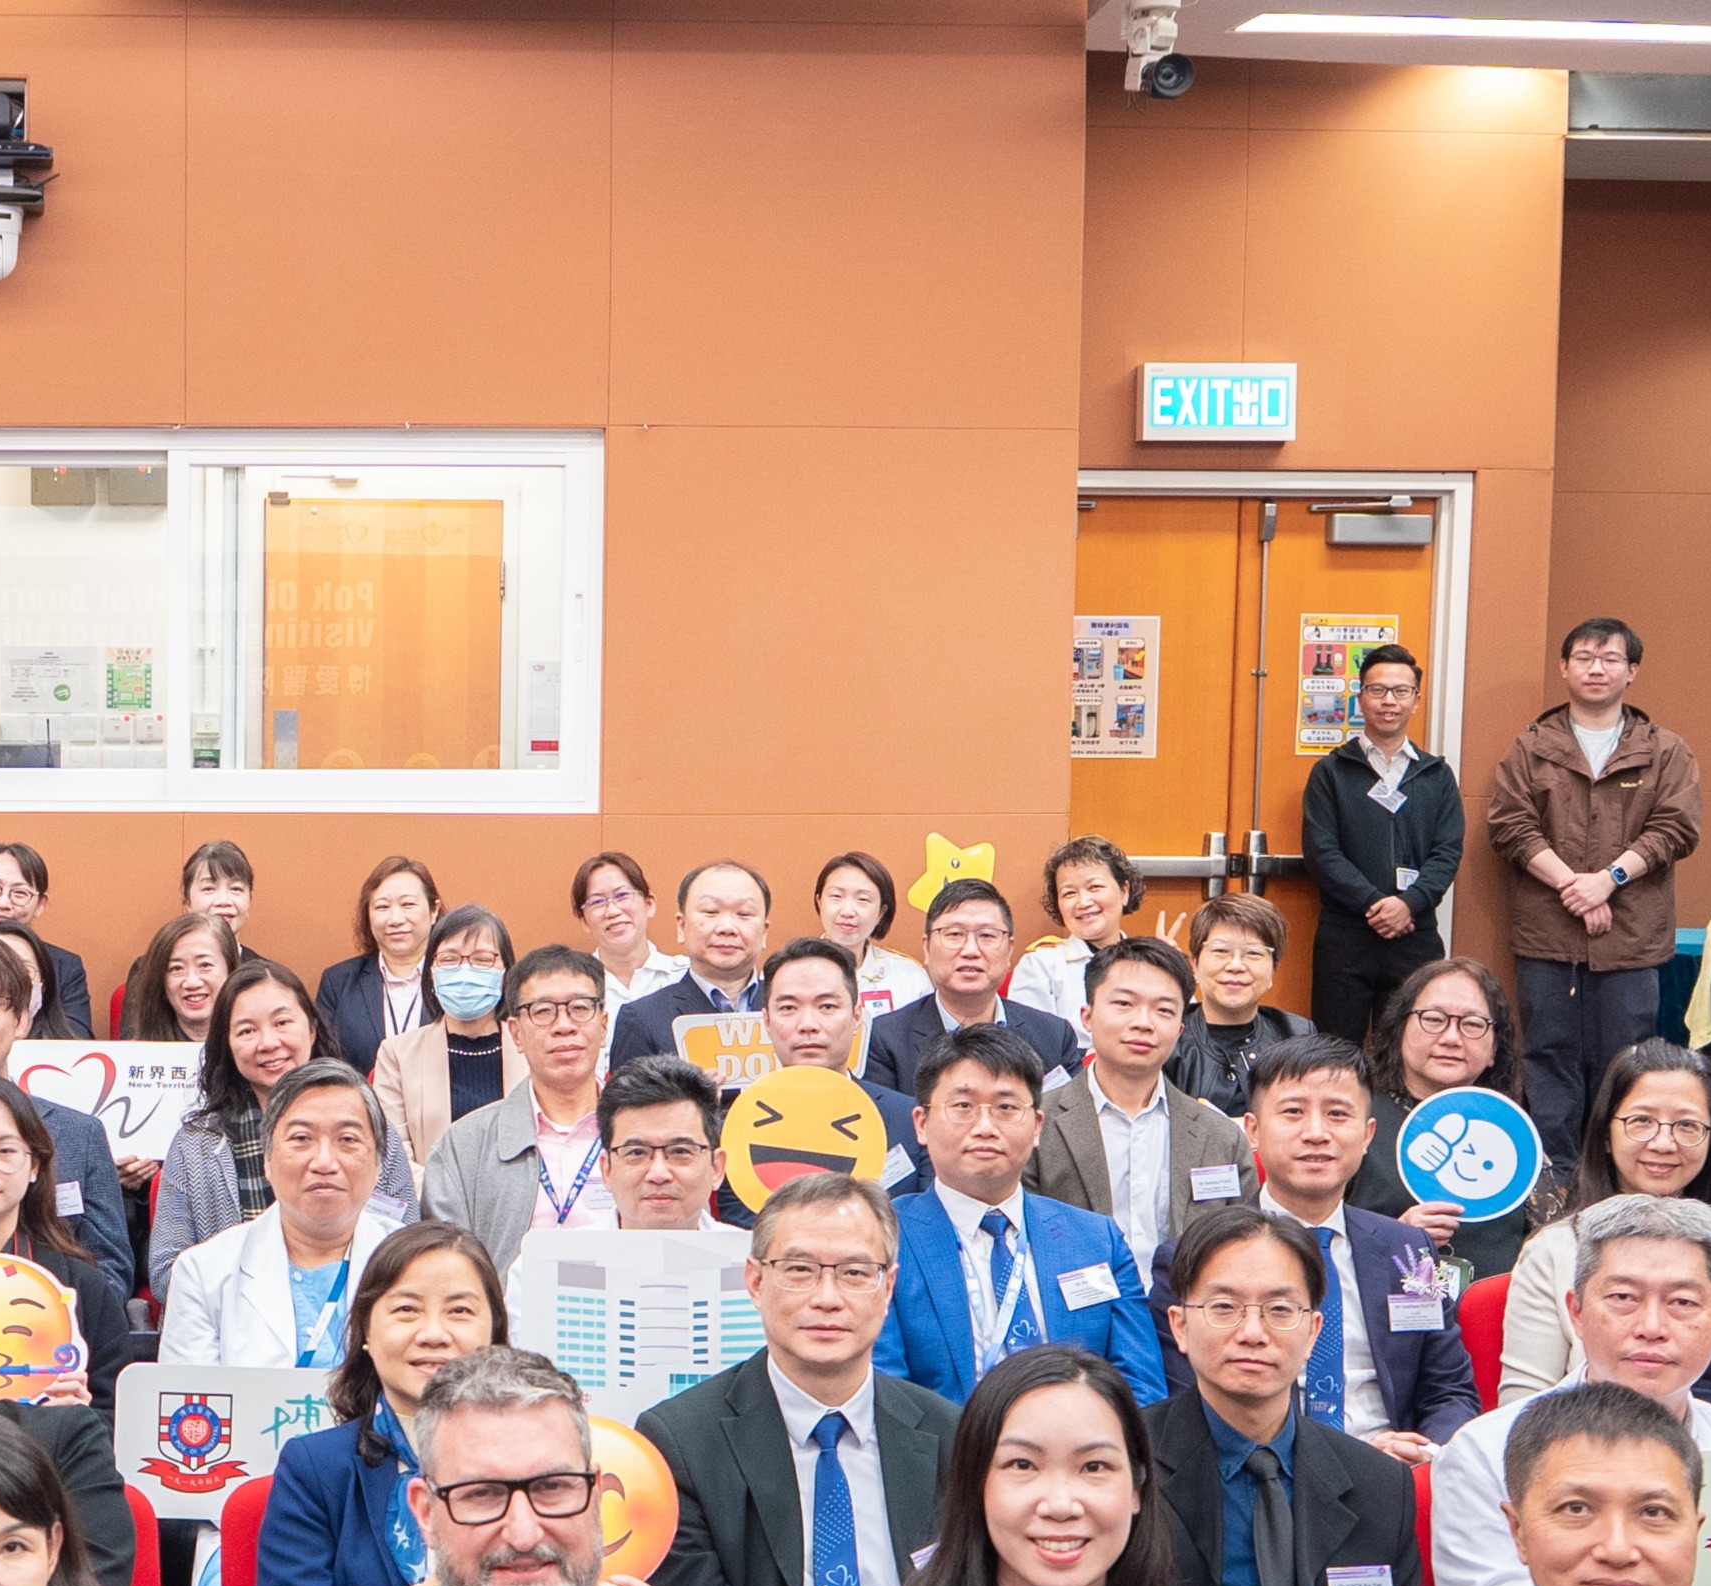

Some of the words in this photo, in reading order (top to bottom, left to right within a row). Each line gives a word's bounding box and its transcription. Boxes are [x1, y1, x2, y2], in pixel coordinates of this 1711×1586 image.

[1153, 379, 1232, 426] EXIT
[1233, 379, 1288, 426] 出口
[128, 1065, 187, 1080] 新界西
[156, 1081, 198, 1089] Territor
